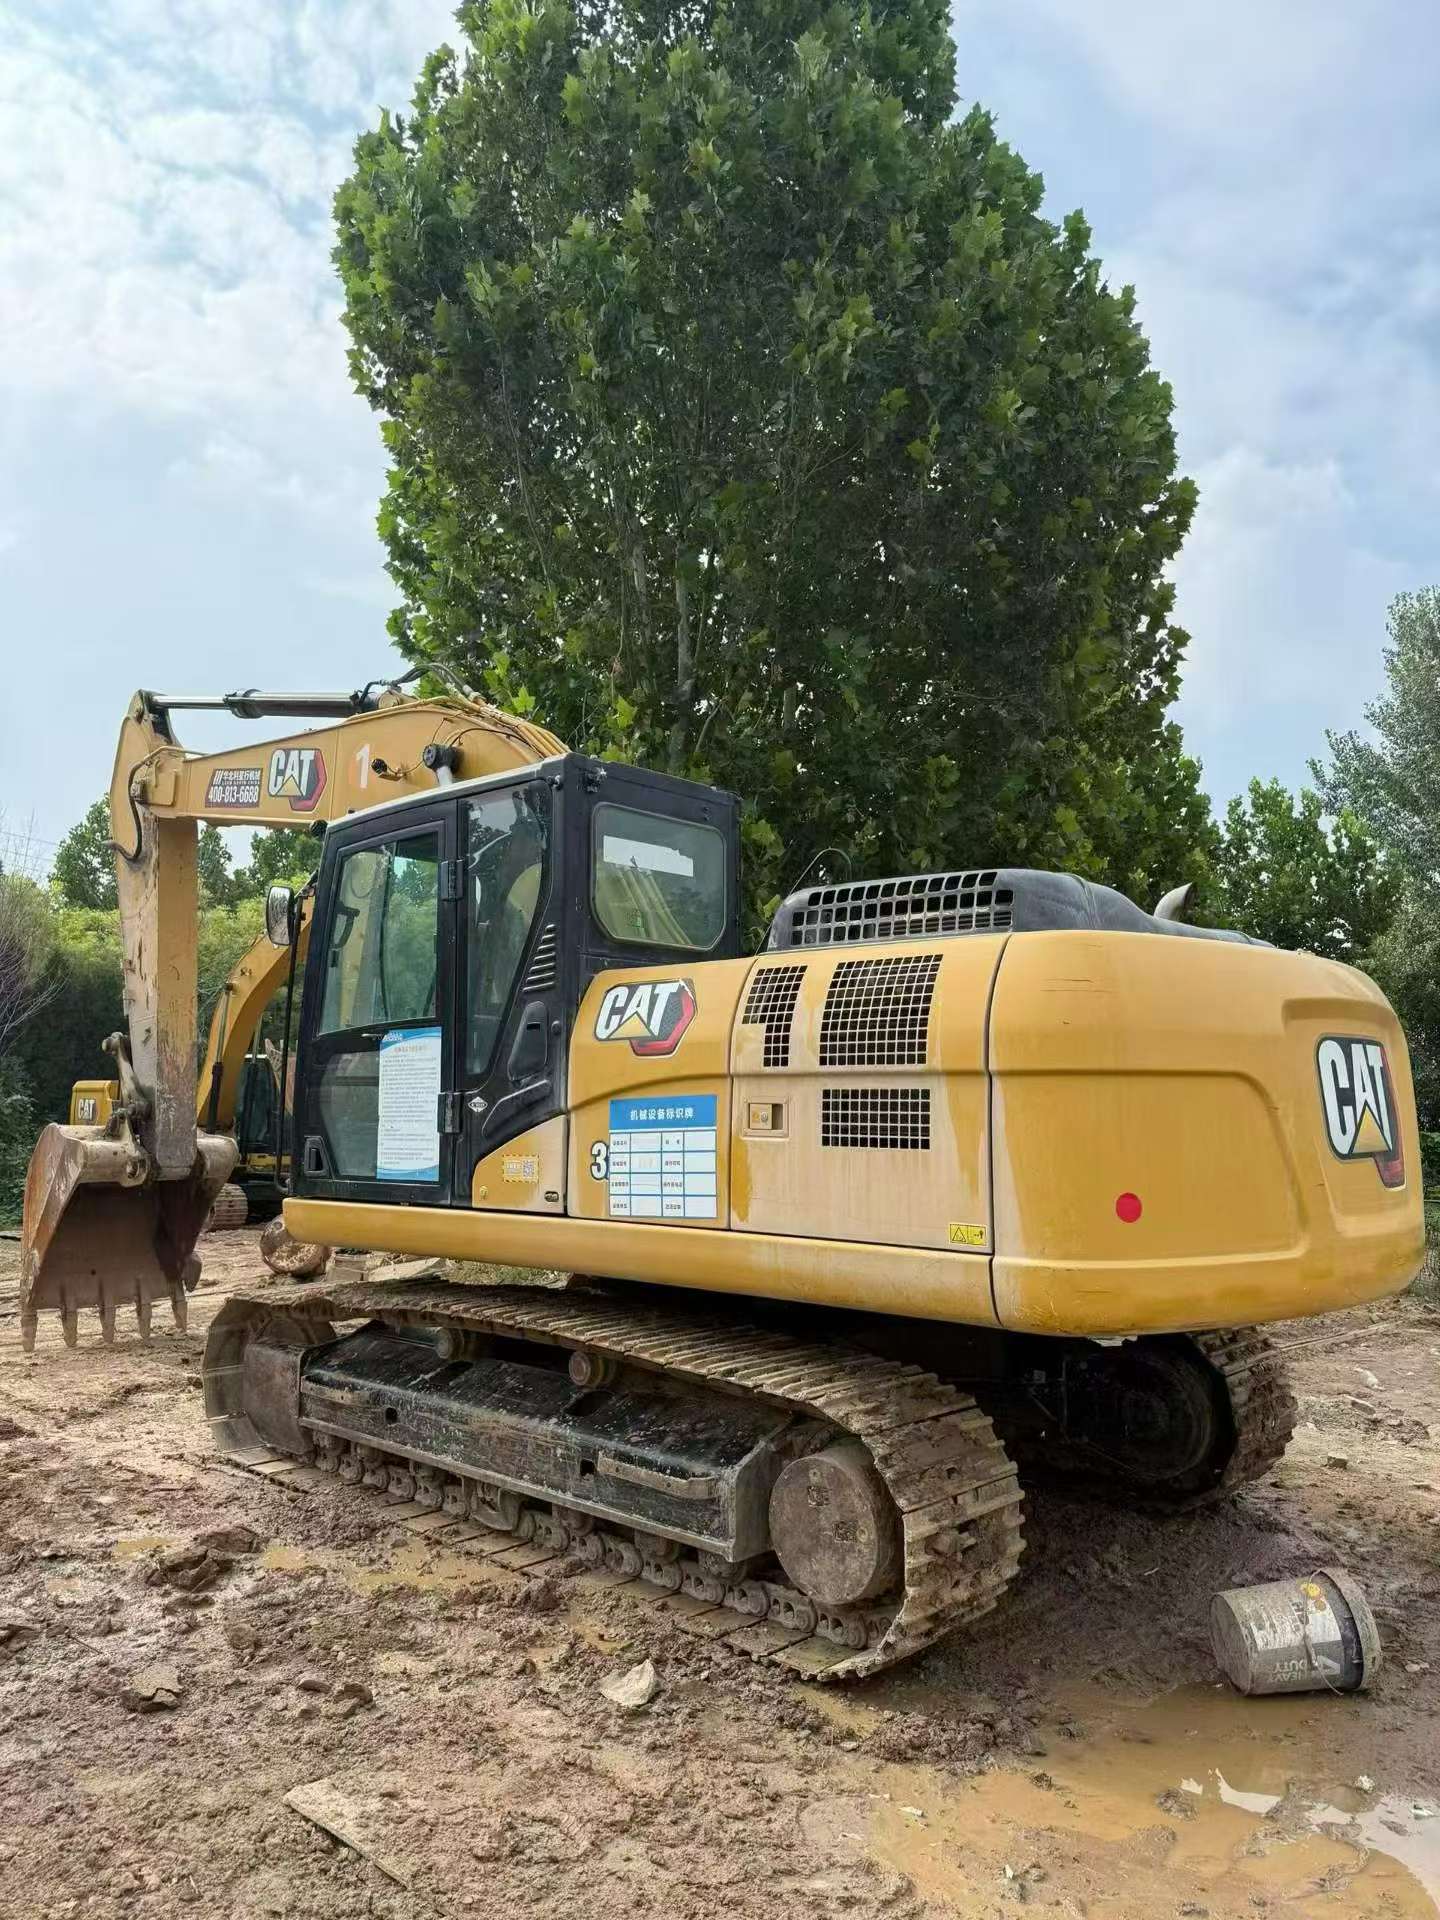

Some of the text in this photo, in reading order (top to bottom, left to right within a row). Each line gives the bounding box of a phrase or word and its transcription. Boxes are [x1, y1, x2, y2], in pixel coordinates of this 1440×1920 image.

[268, 749, 315, 797] CAT
[356, 744, 371, 789] 1
[595, 982, 680, 1039] CAT
[78, 1098, 96, 1120] CAT
[630, 1107, 694, 1121] 机械设备标识牌
[1318, 1039, 1393, 1155] CAT
